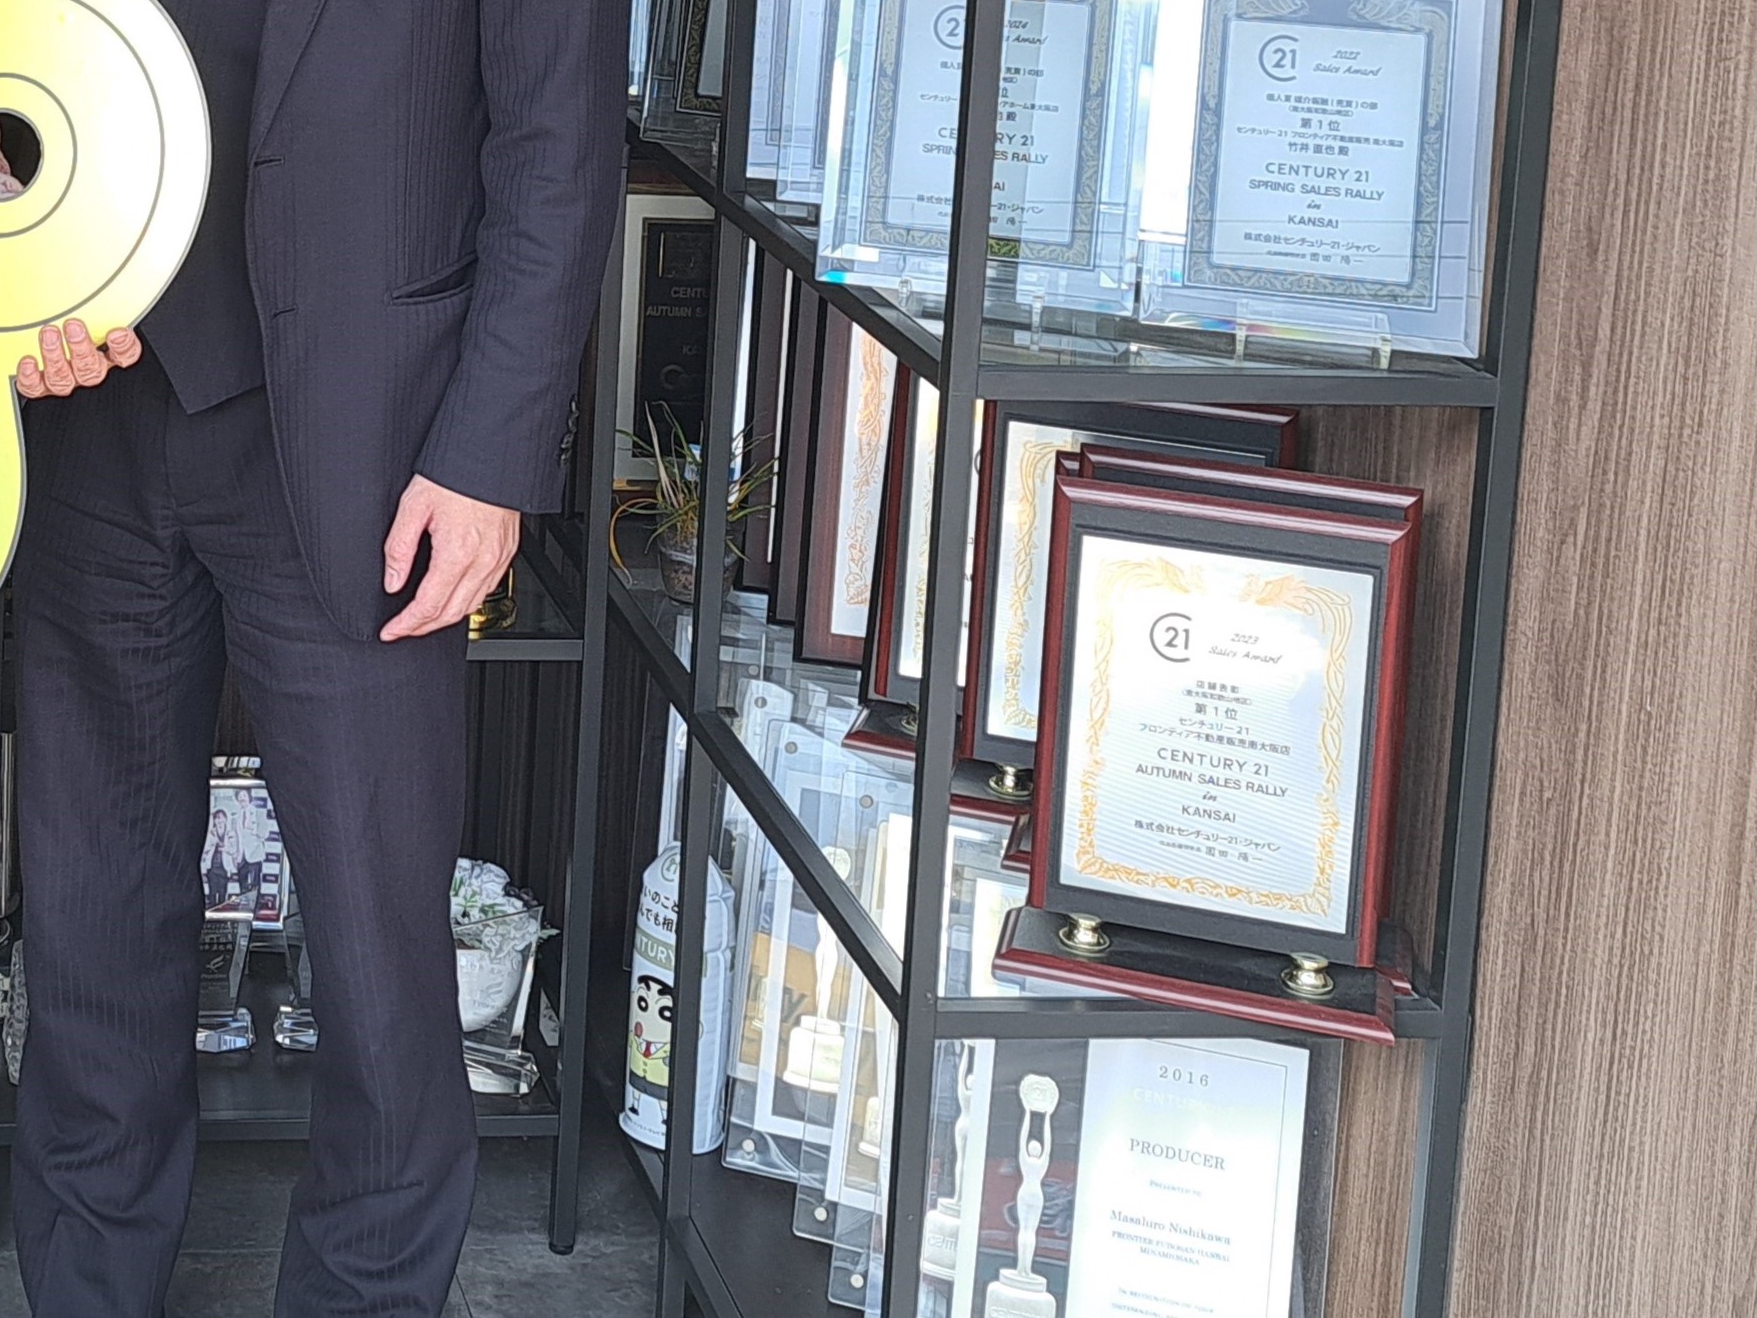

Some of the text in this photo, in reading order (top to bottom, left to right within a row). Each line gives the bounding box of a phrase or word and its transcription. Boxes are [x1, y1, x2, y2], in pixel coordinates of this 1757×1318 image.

[1020, 135, 1035, 147] 21
[1265, 162, 1370, 183] CENTURY 21
[1249, 178, 1385, 201] SPRING SALES RALLY
[1287, 214, 1340, 229] KANSAI
[646, 305, 692, 318] AUTUMN
[1156, 747, 1270, 777] CENTURY 21
[1135, 763, 1289, 798] AUTUMN SALES RALLY
[1181, 804, 1237, 824] KANSAI
[1158, 1064, 1210, 1088] 2016
[1129, 1137, 1227, 1171] PRODUCER
[1109, 1209, 1232, 1246] Masahiro Nishikawa
